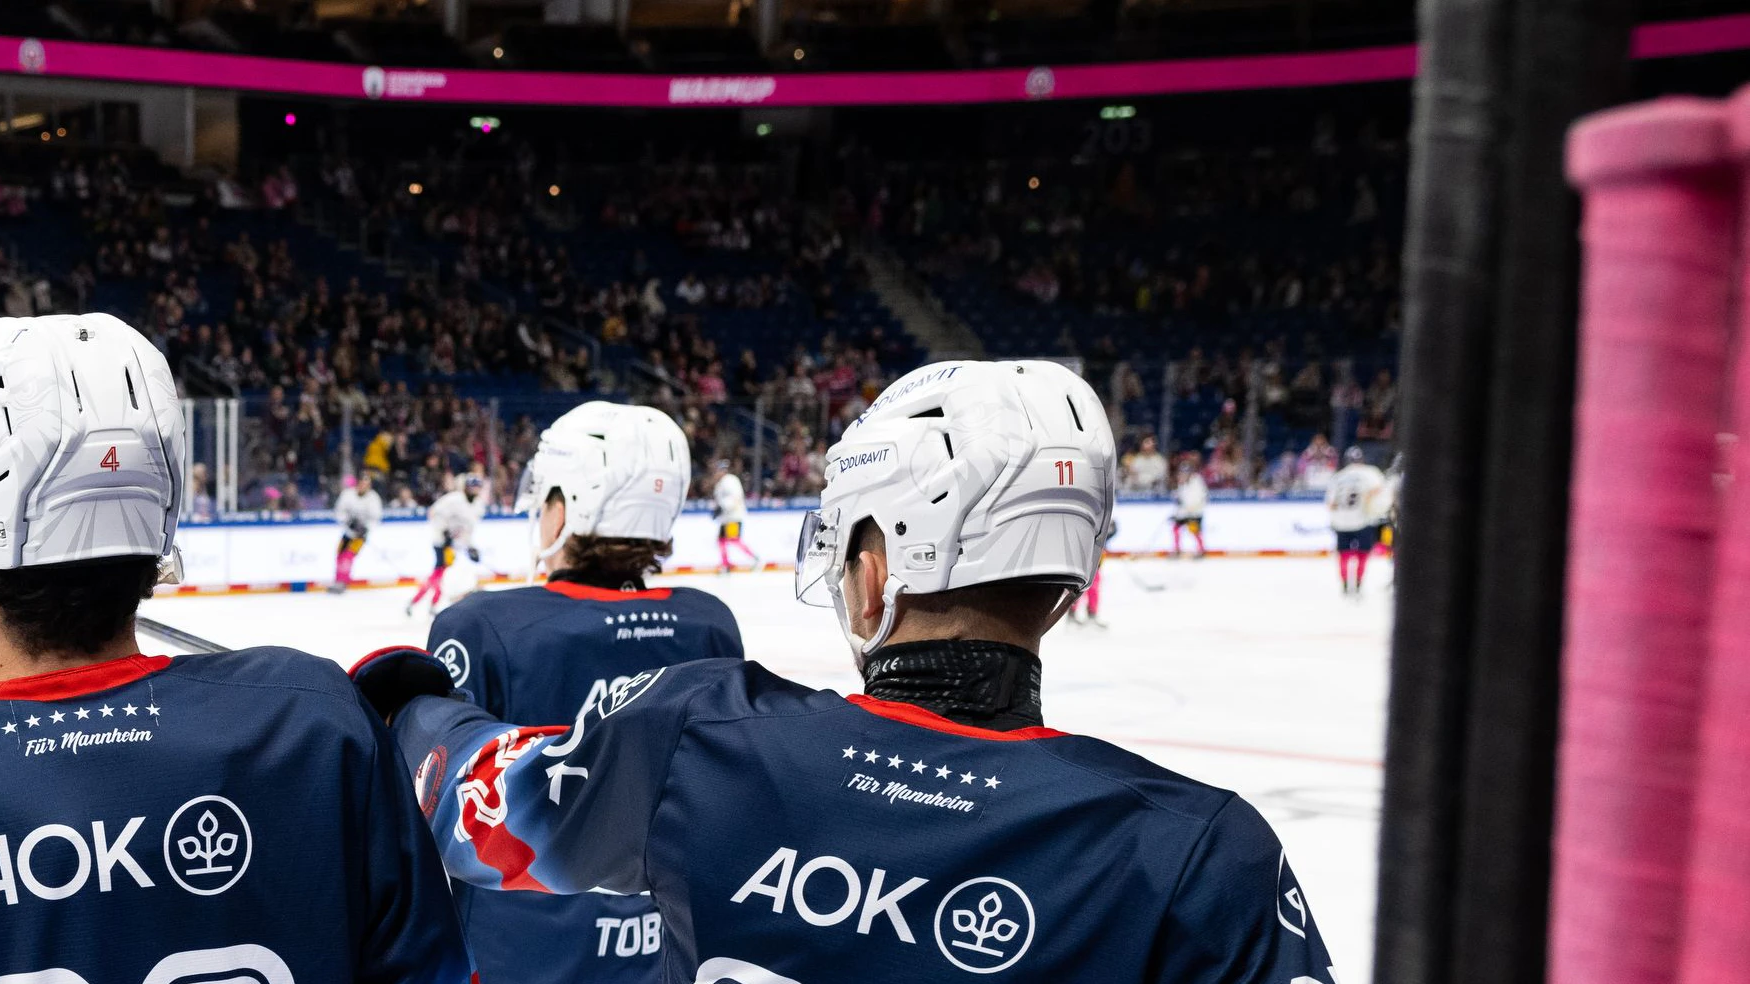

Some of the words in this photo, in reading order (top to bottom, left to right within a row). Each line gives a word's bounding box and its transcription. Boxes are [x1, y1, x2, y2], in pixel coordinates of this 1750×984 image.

[100, 446, 120, 472] 4
[848, 448, 890, 470] DURAVIT
[654, 478, 664, 493] 9
[1054, 460, 1074, 486] 11
[24, 735, 57, 757] Für
[61, 727, 153, 755] Mannheim
[848, 773, 881, 796] Für
[881, 781, 974, 813] Mannheim
[730, 846, 930, 944] AOK
